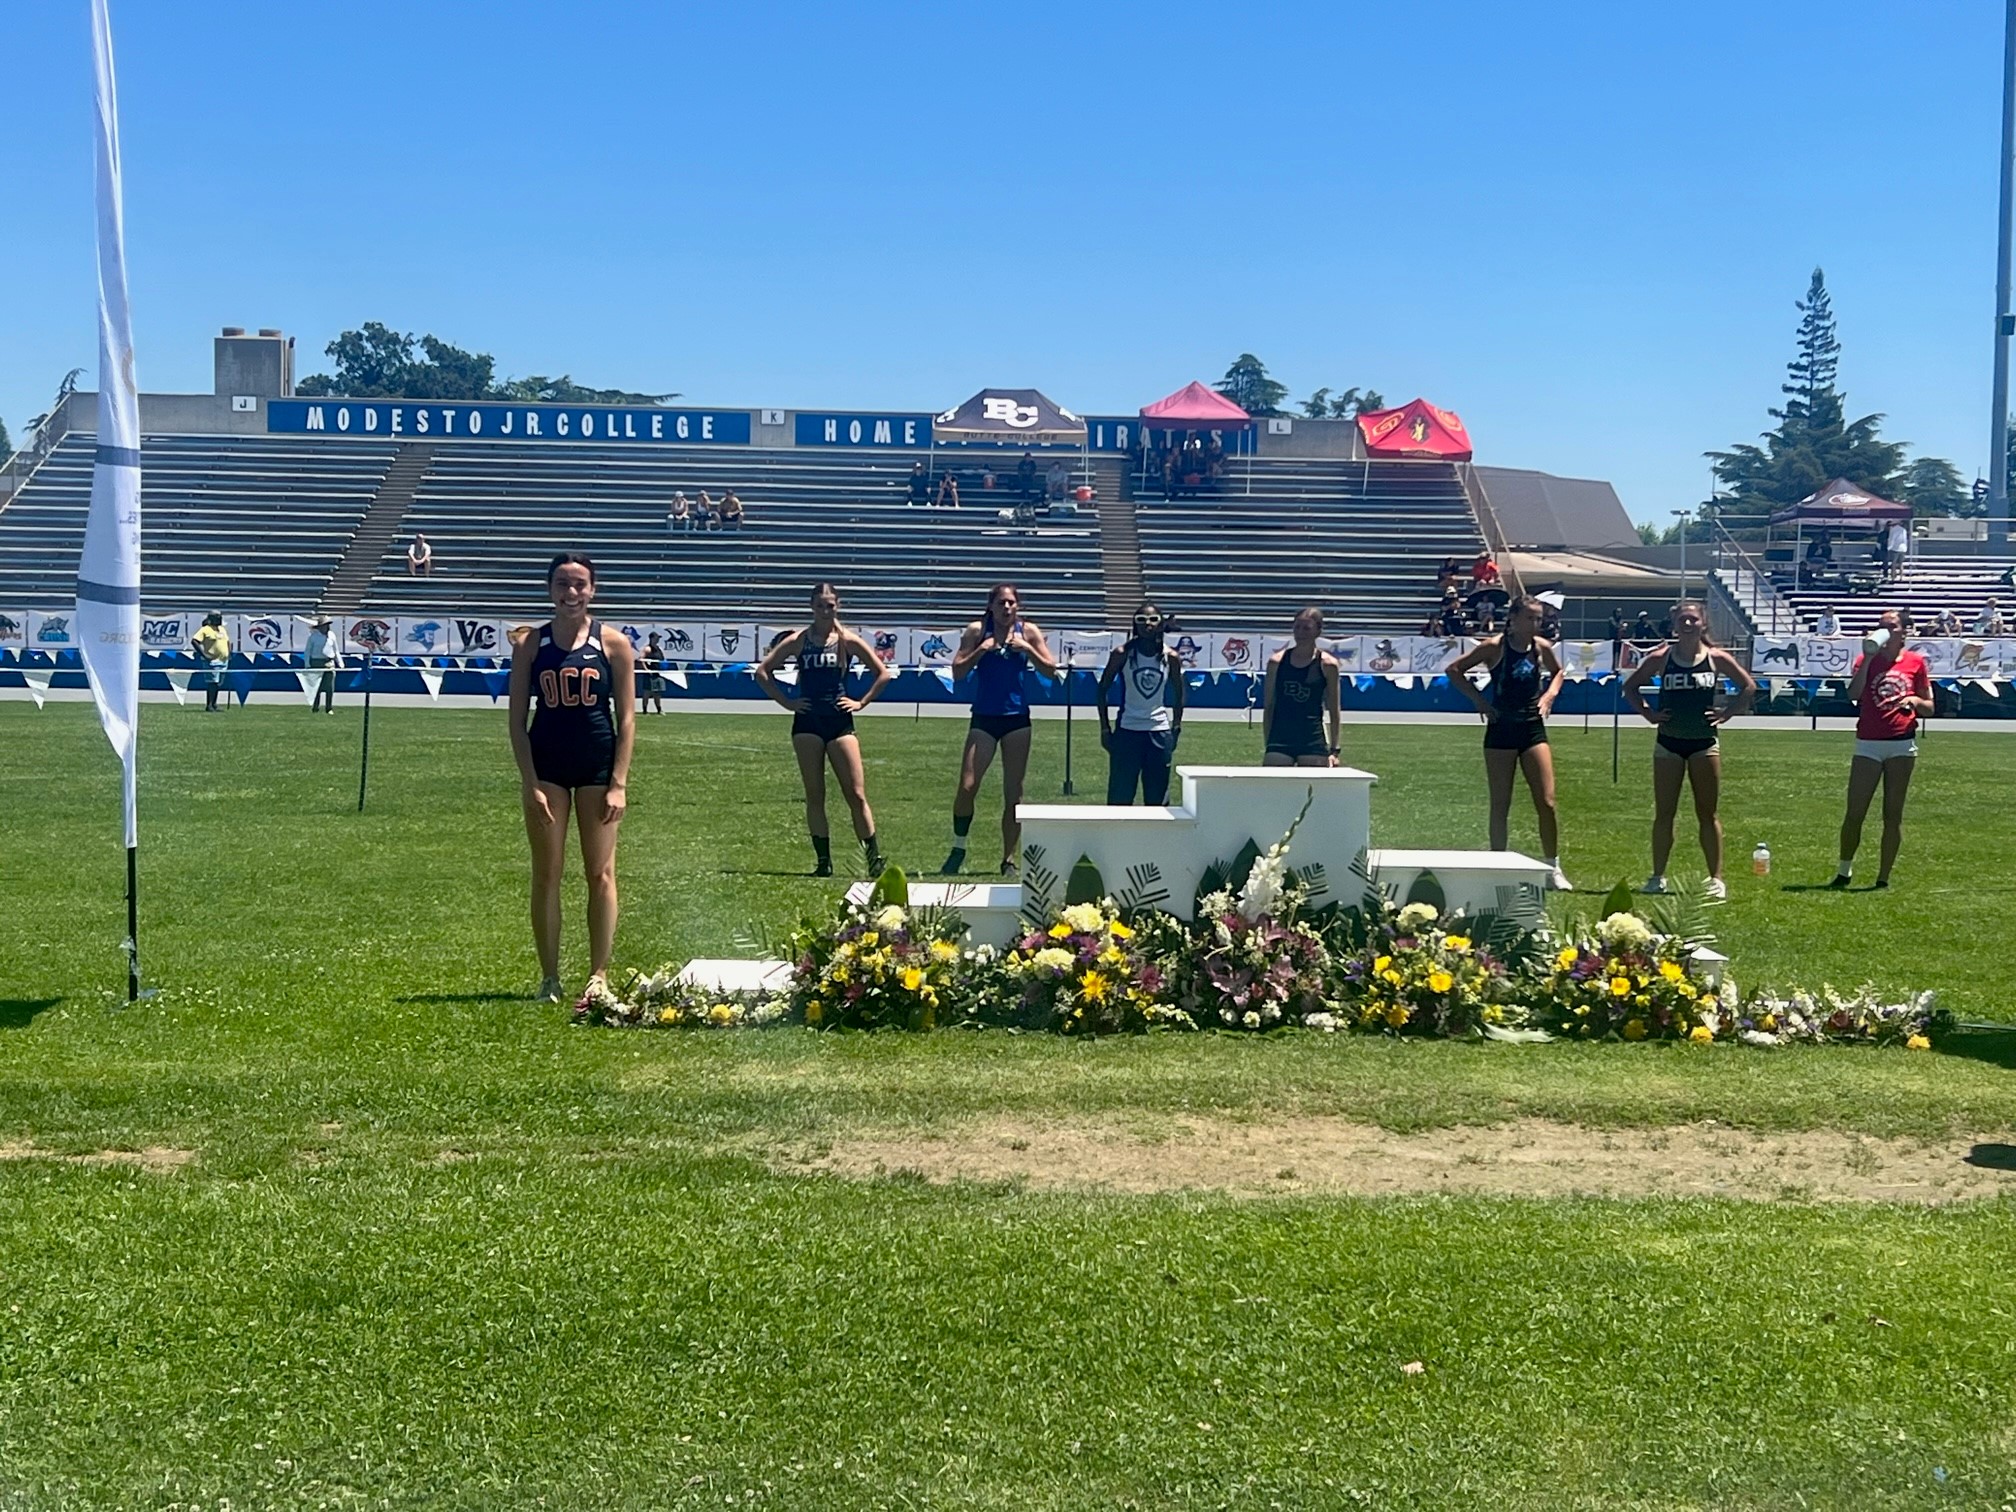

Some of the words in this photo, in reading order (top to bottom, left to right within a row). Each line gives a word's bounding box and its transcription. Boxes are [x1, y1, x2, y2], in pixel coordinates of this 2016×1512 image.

[239, 399, 248, 409] J
[983, 398, 1039, 428] BC
[306, 407, 482, 434] MODESTO
[556, 413, 714, 439] COLLEGE
[770, 412, 778, 423] K
[1276, 422, 1285, 432] L
[824, 419, 916, 444] HOME
[143, 620, 180, 637] MC
[454, 620, 497, 650] VC
[664, 640, 694, 652] DVC
[1806, 640, 1849, 672] BC
[802, 653, 842, 669] YUB
[540, 667, 600, 708] OCC
